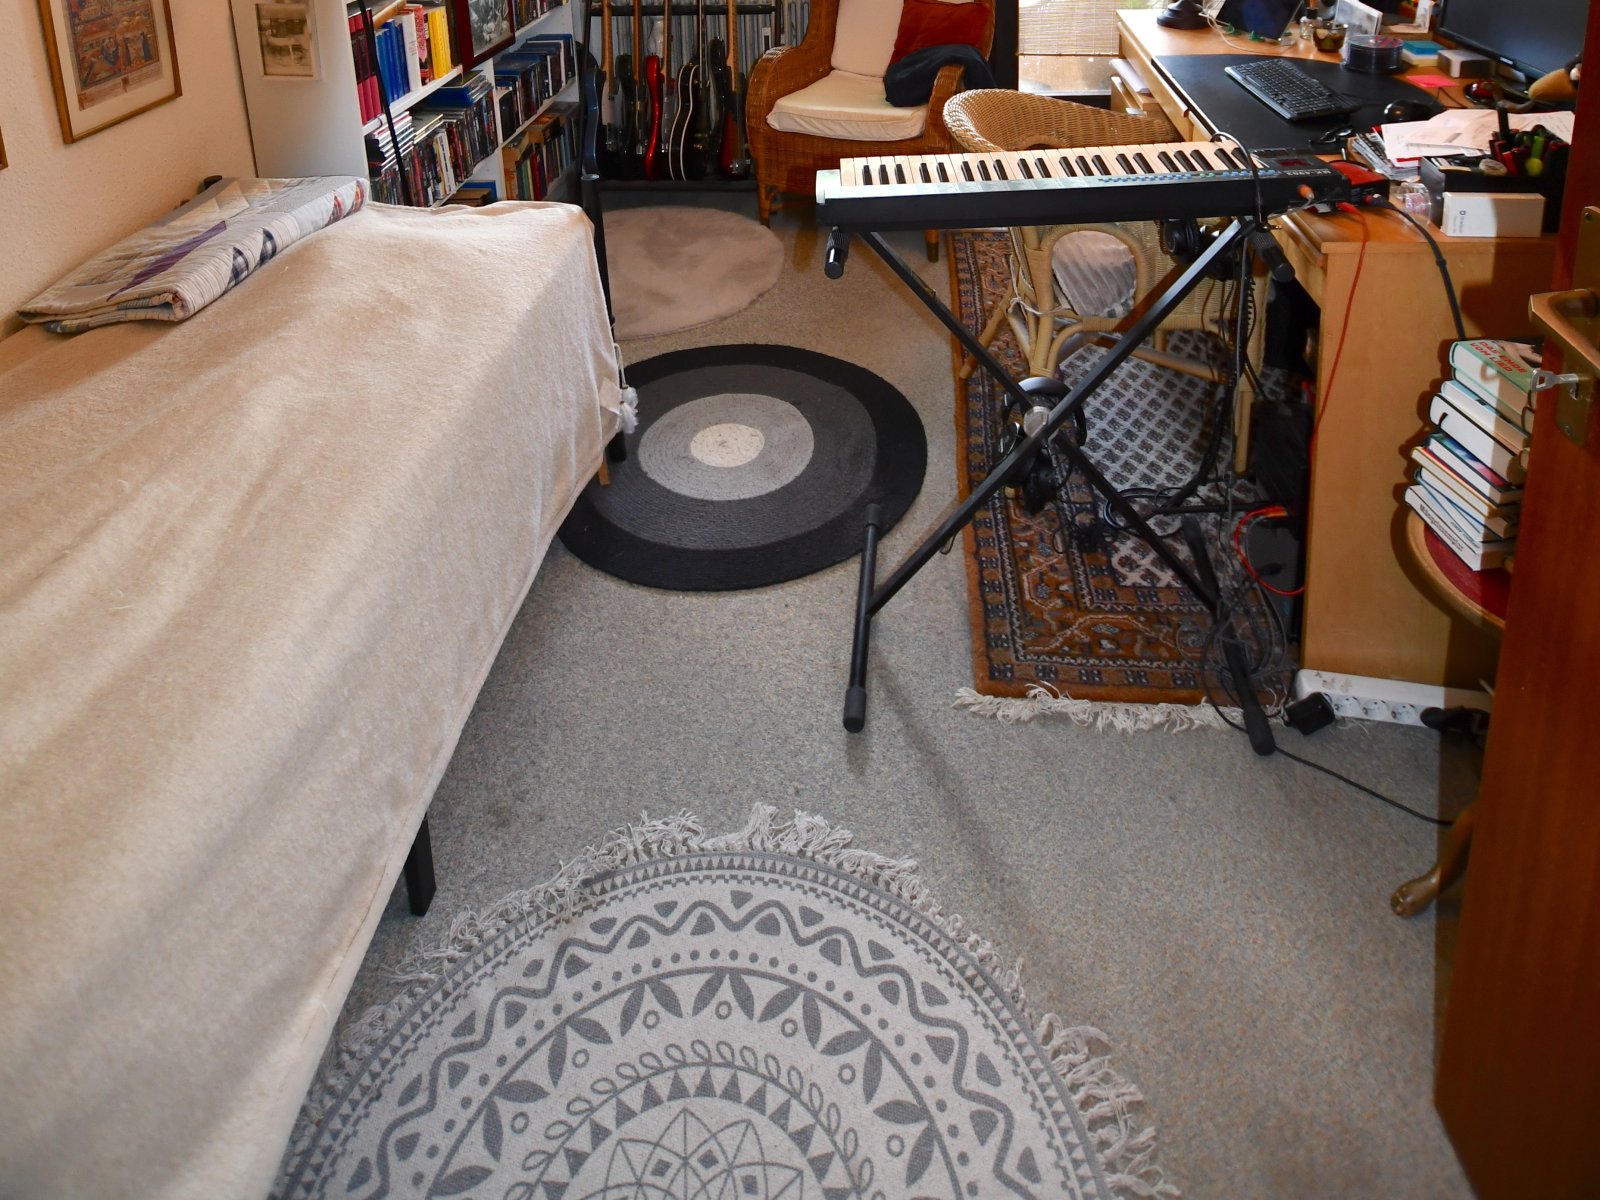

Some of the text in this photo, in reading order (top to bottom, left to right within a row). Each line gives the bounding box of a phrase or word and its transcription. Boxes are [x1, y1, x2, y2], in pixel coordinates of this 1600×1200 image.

[1470, 343, 1513, 372] VOM LIED
[1479, 341, 1528, 373] DAS ENDE
